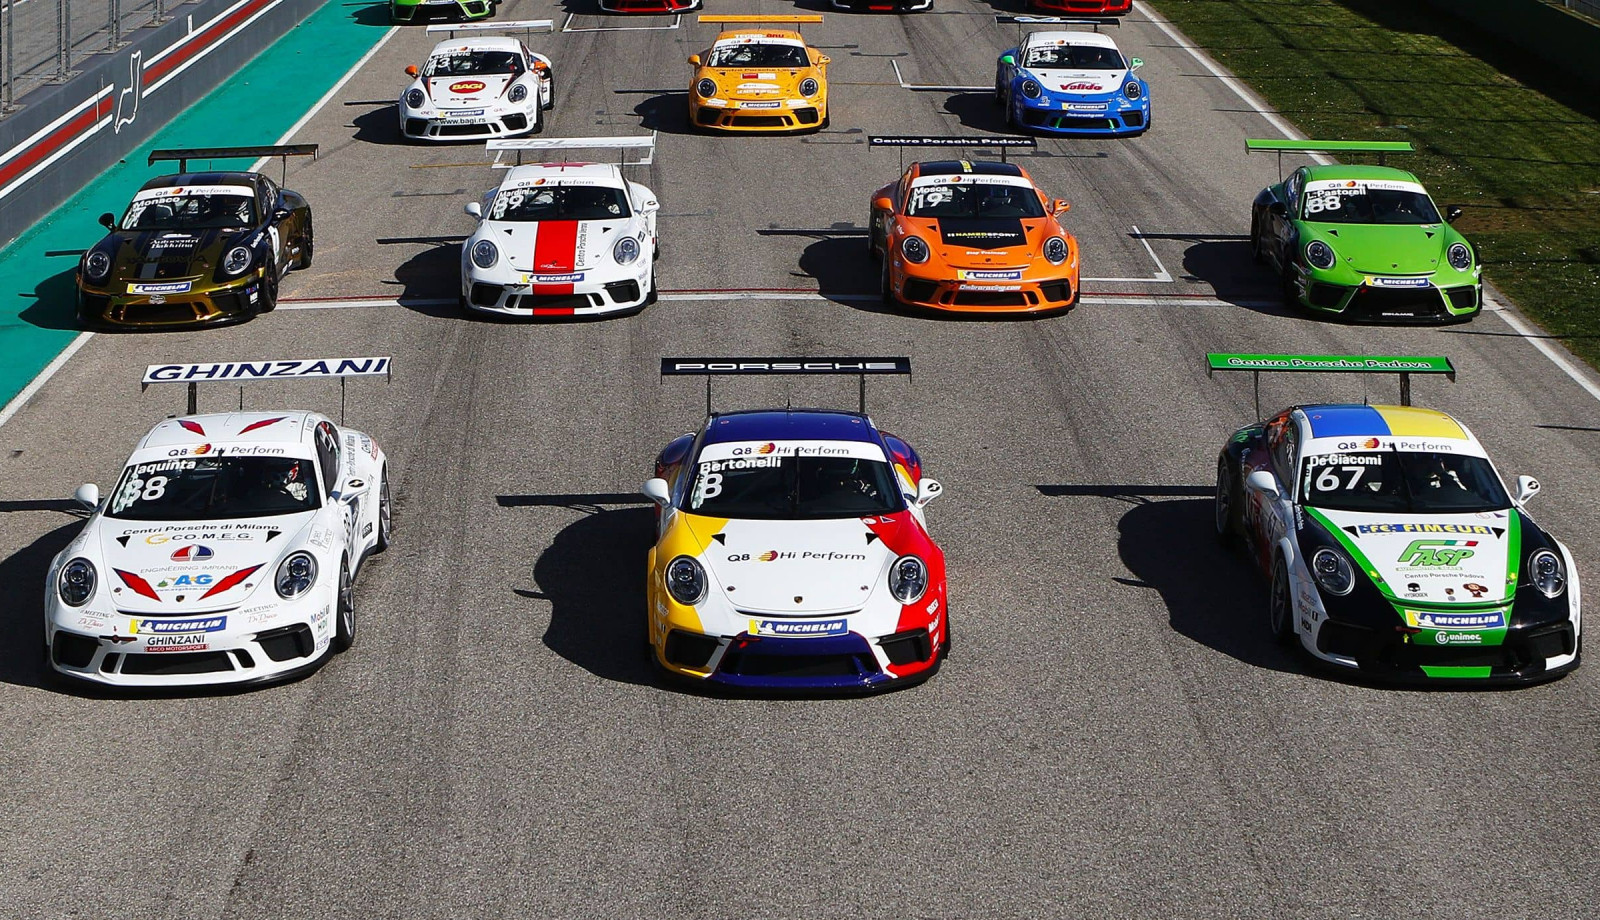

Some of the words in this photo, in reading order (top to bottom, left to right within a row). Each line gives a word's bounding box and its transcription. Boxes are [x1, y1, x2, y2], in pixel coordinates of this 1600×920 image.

[1060, 83, 1103, 91] Valido
[440, 116, 486, 125] www.bagi.rs
[914, 186, 948, 196] Mosca
[133, 196, 181, 210] Monaco
[1308, 196, 1342, 214] 88
[144, 284, 187, 292] MICHELIN
[674, 362, 896, 371] PORSCHE
[1228, 357, 1288, 367] Centro
[1291, 358, 1364, 368] Porsche
[1365, 359, 1432, 369] Padova
[149, 358, 388, 380] GHINZANI
[168, 448, 188, 457] Q8
[229, 446, 284, 456] Perform
[732, 446, 752, 456] Q8
[777, 446, 792, 455] Hi
[796, 446, 850, 457] Perform
[1338, 442, 1358, 450] Q8
[1400, 441, 1452, 451] Perform
[700, 456, 782, 474] Bertonelli
[1309, 455, 1326, 468] De
[1328, 454, 1382, 466] Giacomi
[1315, 466, 1366, 492] 67
[700, 473, 722, 498] 8
[122, 526, 162, 536] Centri
[164, 524, 218, 532] Porsche
[1405, 524, 1488, 534] FIMEUR
[727, 553, 750, 562] Q8
[780, 552, 797, 560] Hi
[802, 551, 866, 562] Perform
[1397, 540, 1475, 566] FASP
[140, 565, 199, 574] ENGINEERING
[154, 620, 222, 630] MICHELIN
[1434, 615, 1499, 625] MICHELIN
[775, 622, 842, 632] MICHELIN
[147, 634, 205, 646] GHINZANI
